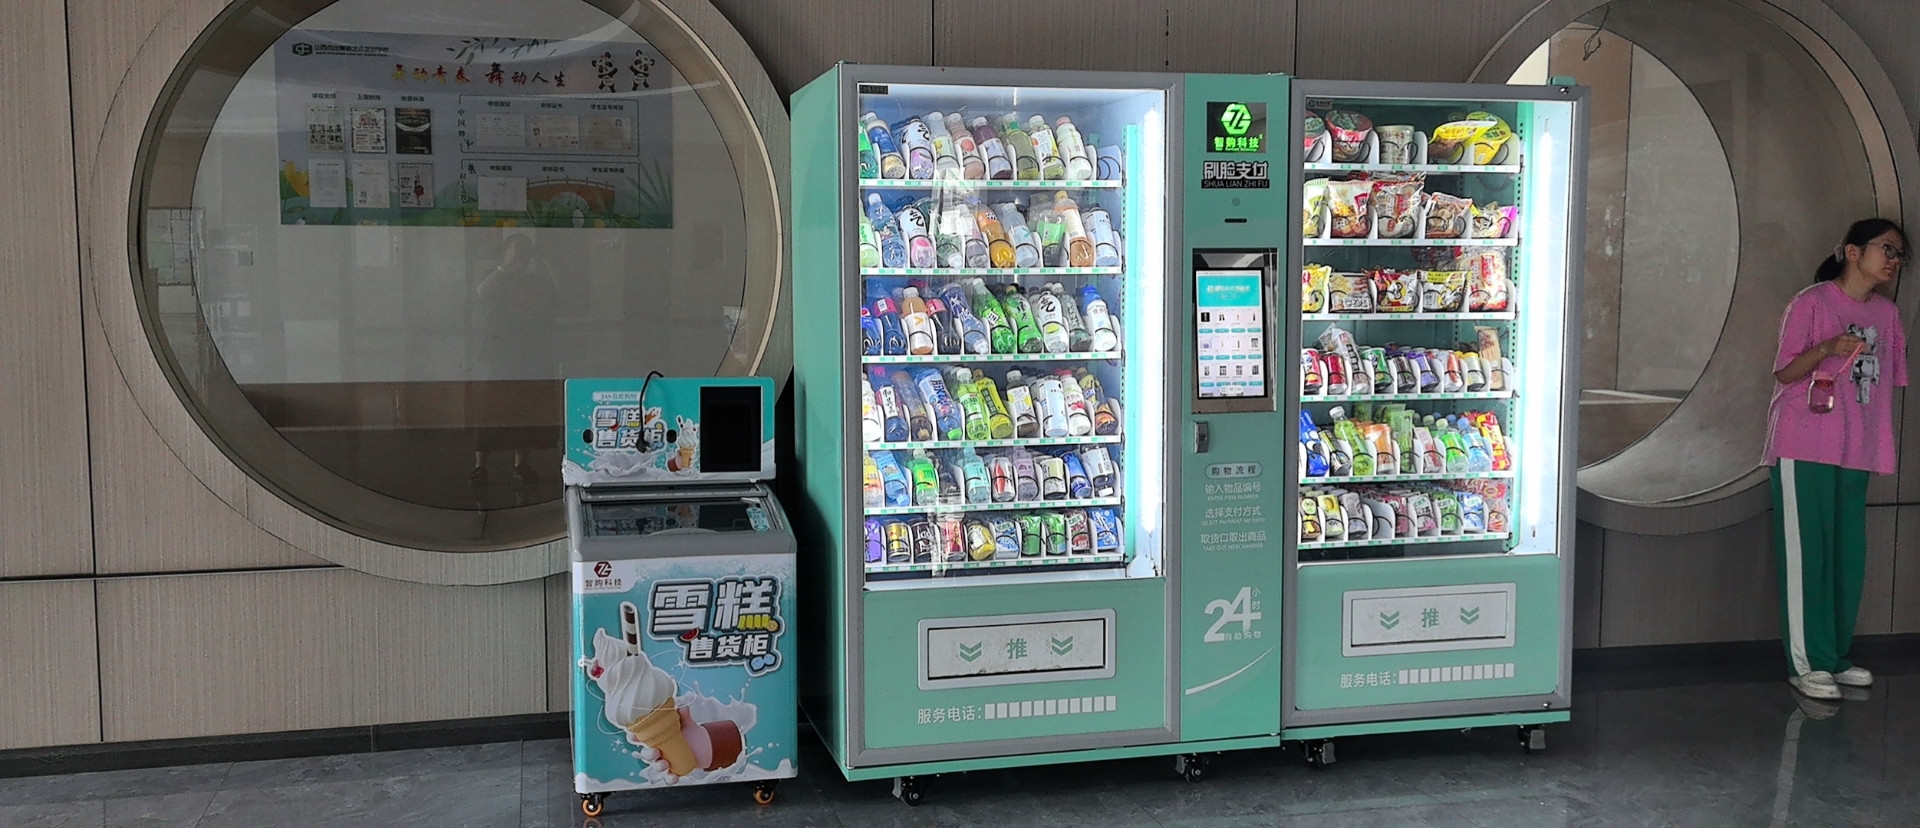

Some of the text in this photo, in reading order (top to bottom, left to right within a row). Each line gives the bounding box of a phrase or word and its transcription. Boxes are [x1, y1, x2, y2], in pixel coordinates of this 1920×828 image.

[485, 62, 566, 87] 舞动人生
[1214, 136, 1260, 148] 智购科技
[1204, 161, 1268, 180] 刷脸支付
[1203, 180, 1268, 188] SHUA LIAN ZHI FU
[597, 407, 642, 428] 雪糕
[597, 429, 665, 448] 售货柜
[1211, 465, 1256, 476] 购物流程
[1204, 481, 1261, 495] 输入物品编号
[1205, 506, 1261, 519] 选择支付方式
[1201, 530, 1267, 544] 取货口取出商品
[585, 578, 622, 588] 智购科技
[653, 579, 774, 633] 雪糕
[1251, 587, 1261, 610] 小时
[1203, 586, 1261, 642] 24
[1421, 607, 1439, 628] 推
[1225, 630, 1262, 641] 自助购物
[689, 633, 769, 660] 售货柜
[1007, 637, 1028, 660] 推
